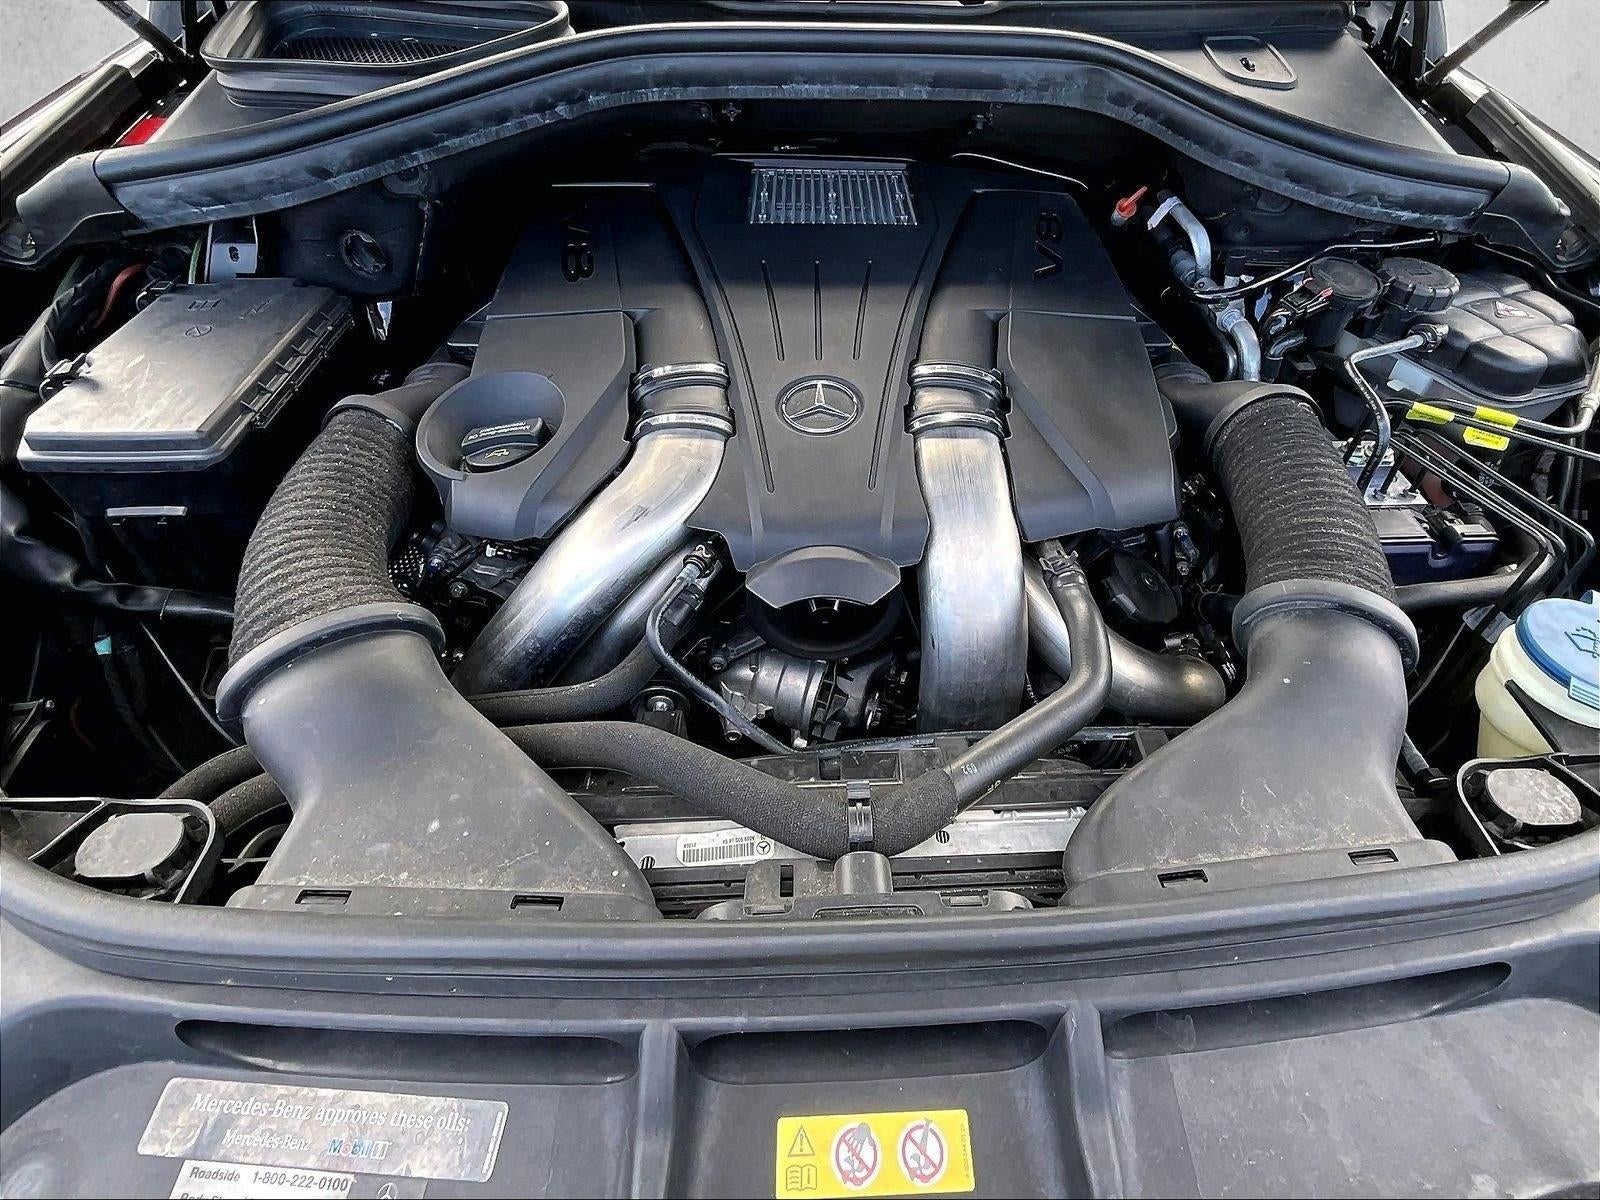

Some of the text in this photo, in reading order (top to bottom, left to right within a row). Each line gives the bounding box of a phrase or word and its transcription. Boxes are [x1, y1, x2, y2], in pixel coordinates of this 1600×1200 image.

[1033, 211, 1064, 281] V8
[190, 1093, 473, 1133] Mercedes-Benz approves these oils:
[221, 1127, 314, 1151] Mercedes-Benz
[188, 1166, 349, 1193] Roadside 1-800-222-0100
